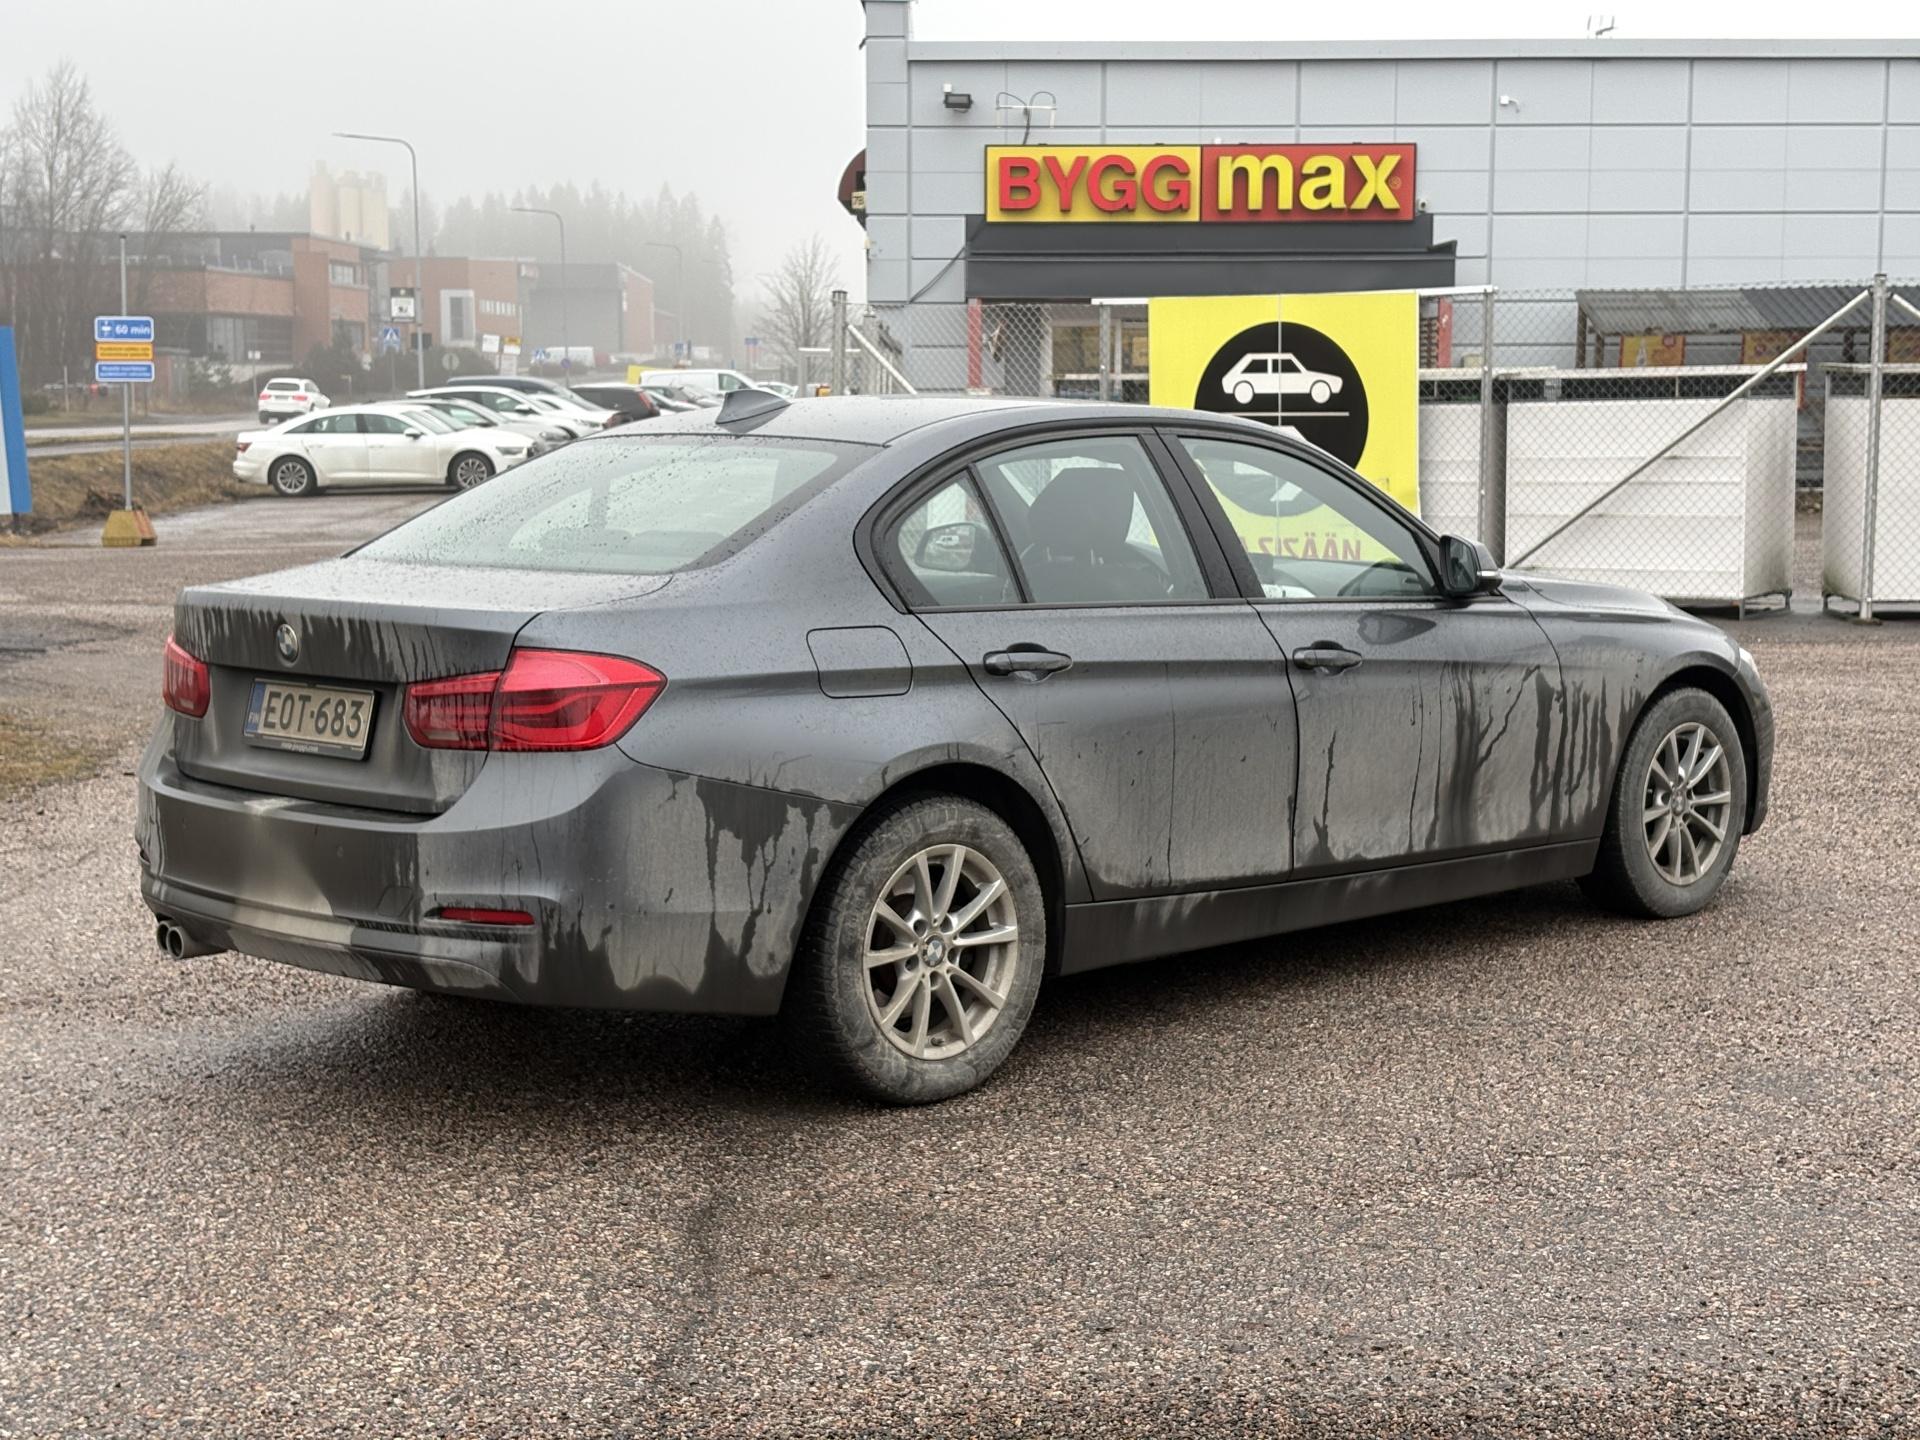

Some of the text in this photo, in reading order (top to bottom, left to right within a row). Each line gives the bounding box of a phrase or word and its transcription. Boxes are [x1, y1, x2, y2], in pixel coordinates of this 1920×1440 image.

[998, 154, 1401, 212] BYGG max
[115, 324, 150, 335] 60 min
[263, 690, 365, 738] EOT-683
